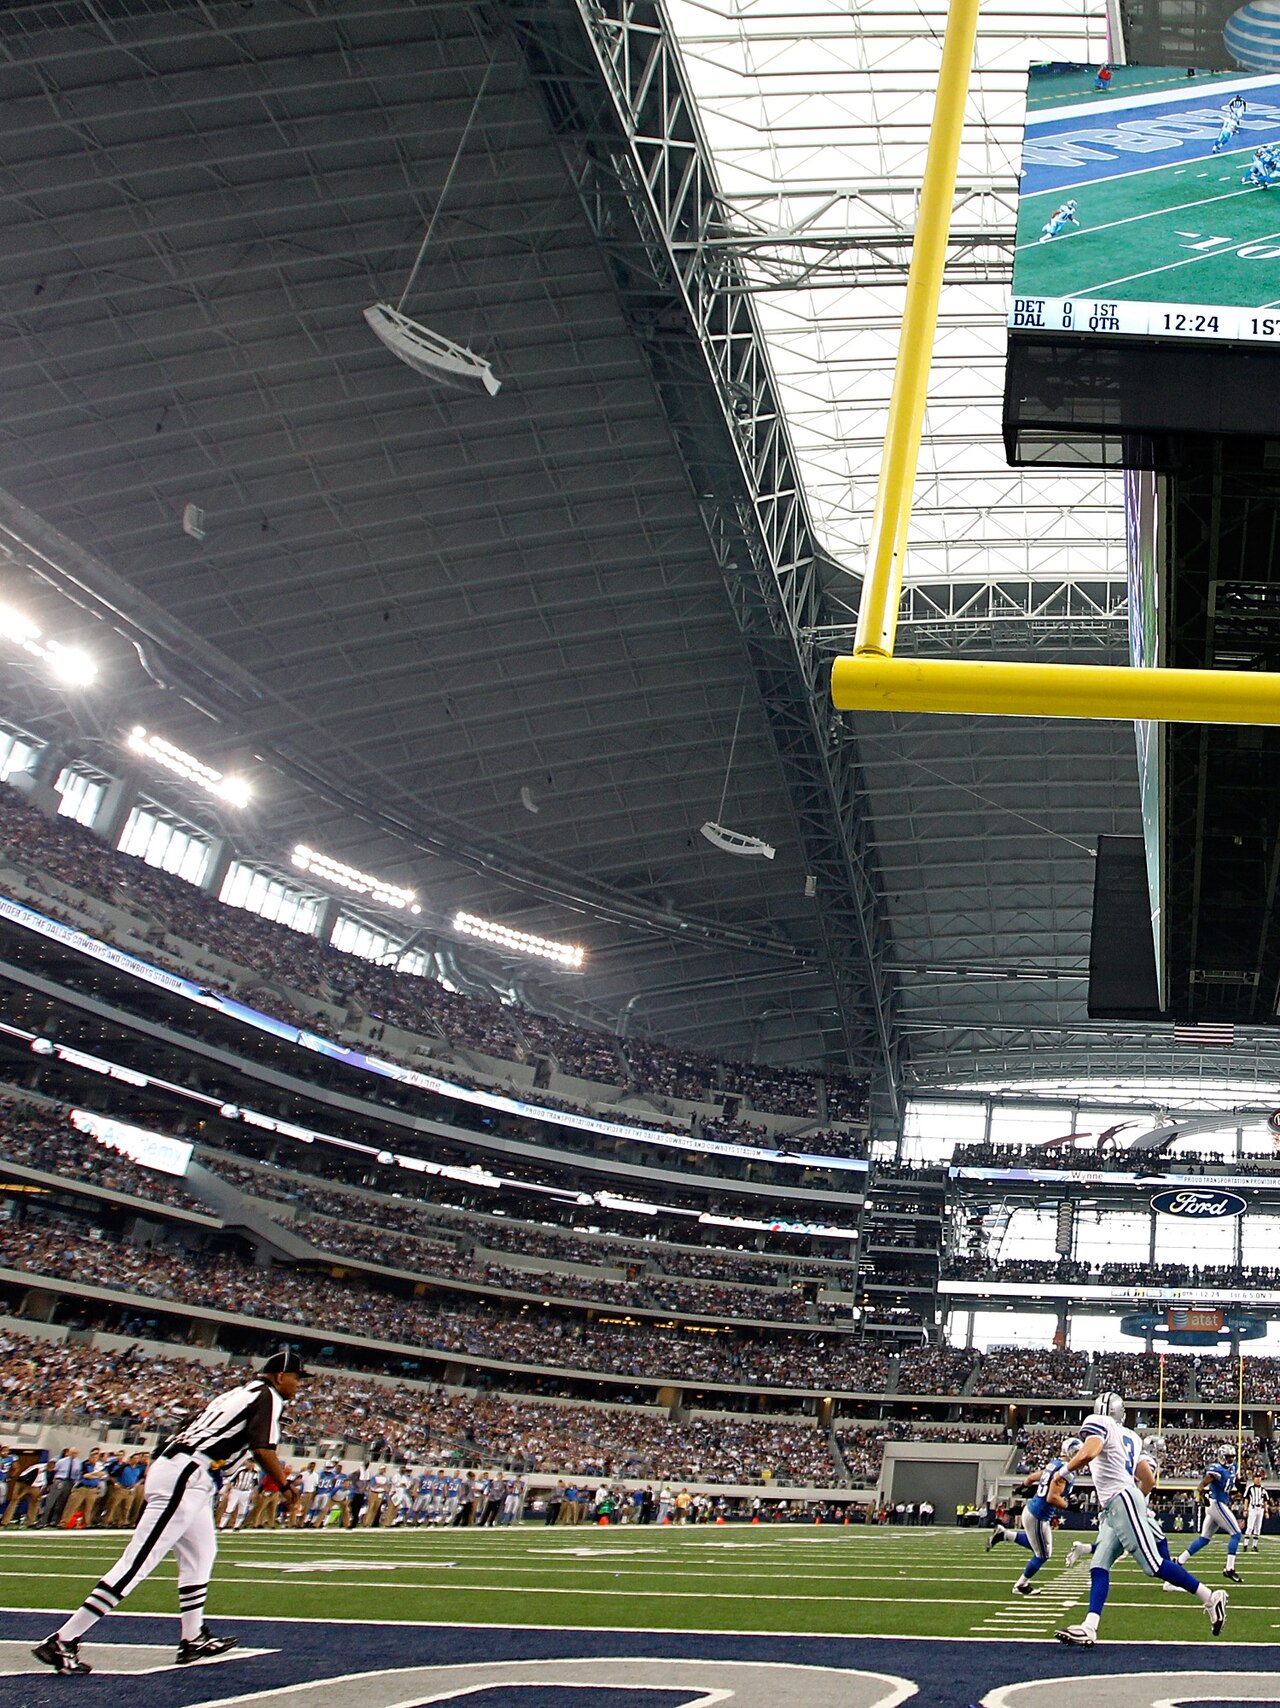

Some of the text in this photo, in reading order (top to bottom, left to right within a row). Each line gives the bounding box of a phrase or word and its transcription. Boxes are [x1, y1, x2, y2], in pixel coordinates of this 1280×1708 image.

[1014, 300, 1073, 315] DET 0
[1093, 303, 1118, 316] 1ST
[1013, 313, 1072, 328] DAL 0
[1088, 316, 1120, 331] QTR
[1163, 313, 1220, 333] 12:24
[47, 923, 72, 941] DALLAS
[72, 933, 107, 957] COWBOYS
[106, 949, 121, 963] AND
[120, 955, 154, 978] COWBOYS
[153, 971, 184, 989] STADIUM
[545, 1109, 595, 1128] TRANSPORTATION
[664, 1133, 694, 1147] COWBOYS
[706, 1142, 737, 1154] COWBOYS
[1071, 1171, 1104, 1183] Wynne
[1184, 1176, 1203, 1184] PROUD
[1203, 1177, 1250, 1185] TRANSPORTATION
[1250, 1178, 1277, 1186] PROVIDER
[1169, 1191, 1229, 1215] Ford
[1191, 1314, 1219, 1327] at&t
[1122, 1435, 1136, 1476] 3
